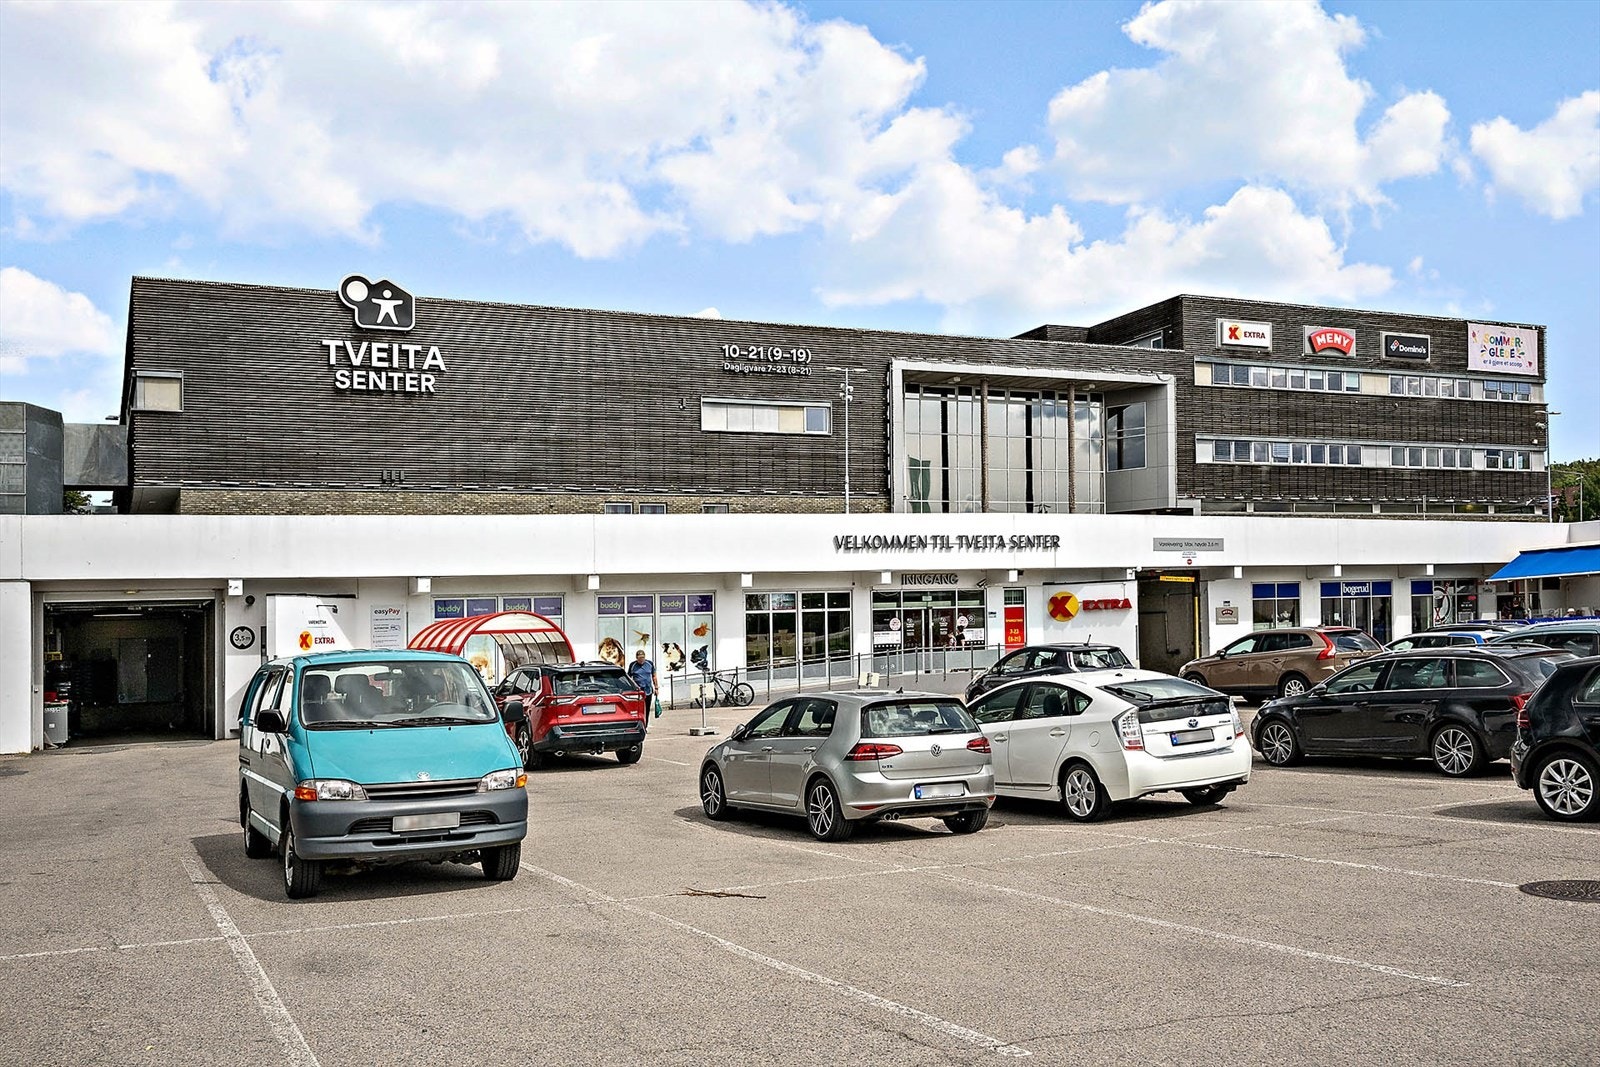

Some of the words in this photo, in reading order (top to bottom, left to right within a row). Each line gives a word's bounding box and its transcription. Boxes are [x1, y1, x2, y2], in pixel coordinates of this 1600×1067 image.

[1244, 331, 1266, 339] EXTRA
[1316, 332, 1350, 347] MENY
[722, 344, 764, 360] 10-21
[1399, 345, 1426, 354] Domino's
[1489, 347, 1515, 358] GLEDE
[322, 339, 447, 372] TVEITA
[724, 362, 766, 373] Dagligvare
[767, 365, 787, 373] 7-23
[335, 369, 435, 392] SENTER
[834, 534, 927, 552] VELKOMMEN
[930, 534, 954, 551] TIL
[956, 534, 1006, 552] TVEITA
[1008, 534, 1060, 551] SENTER
[901, 573, 958, 586] INNGANG
[1343, 583, 1369, 595] bogerud
[437, 605, 460, 613] buddy
[505, 603, 528, 611] buddy
[600, 602, 621, 610] buddy
[662, 600, 683, 608] buddy
[1083, 598, 1132, 610] EXTRA
[314, 637, 336, 645] EXTRA
